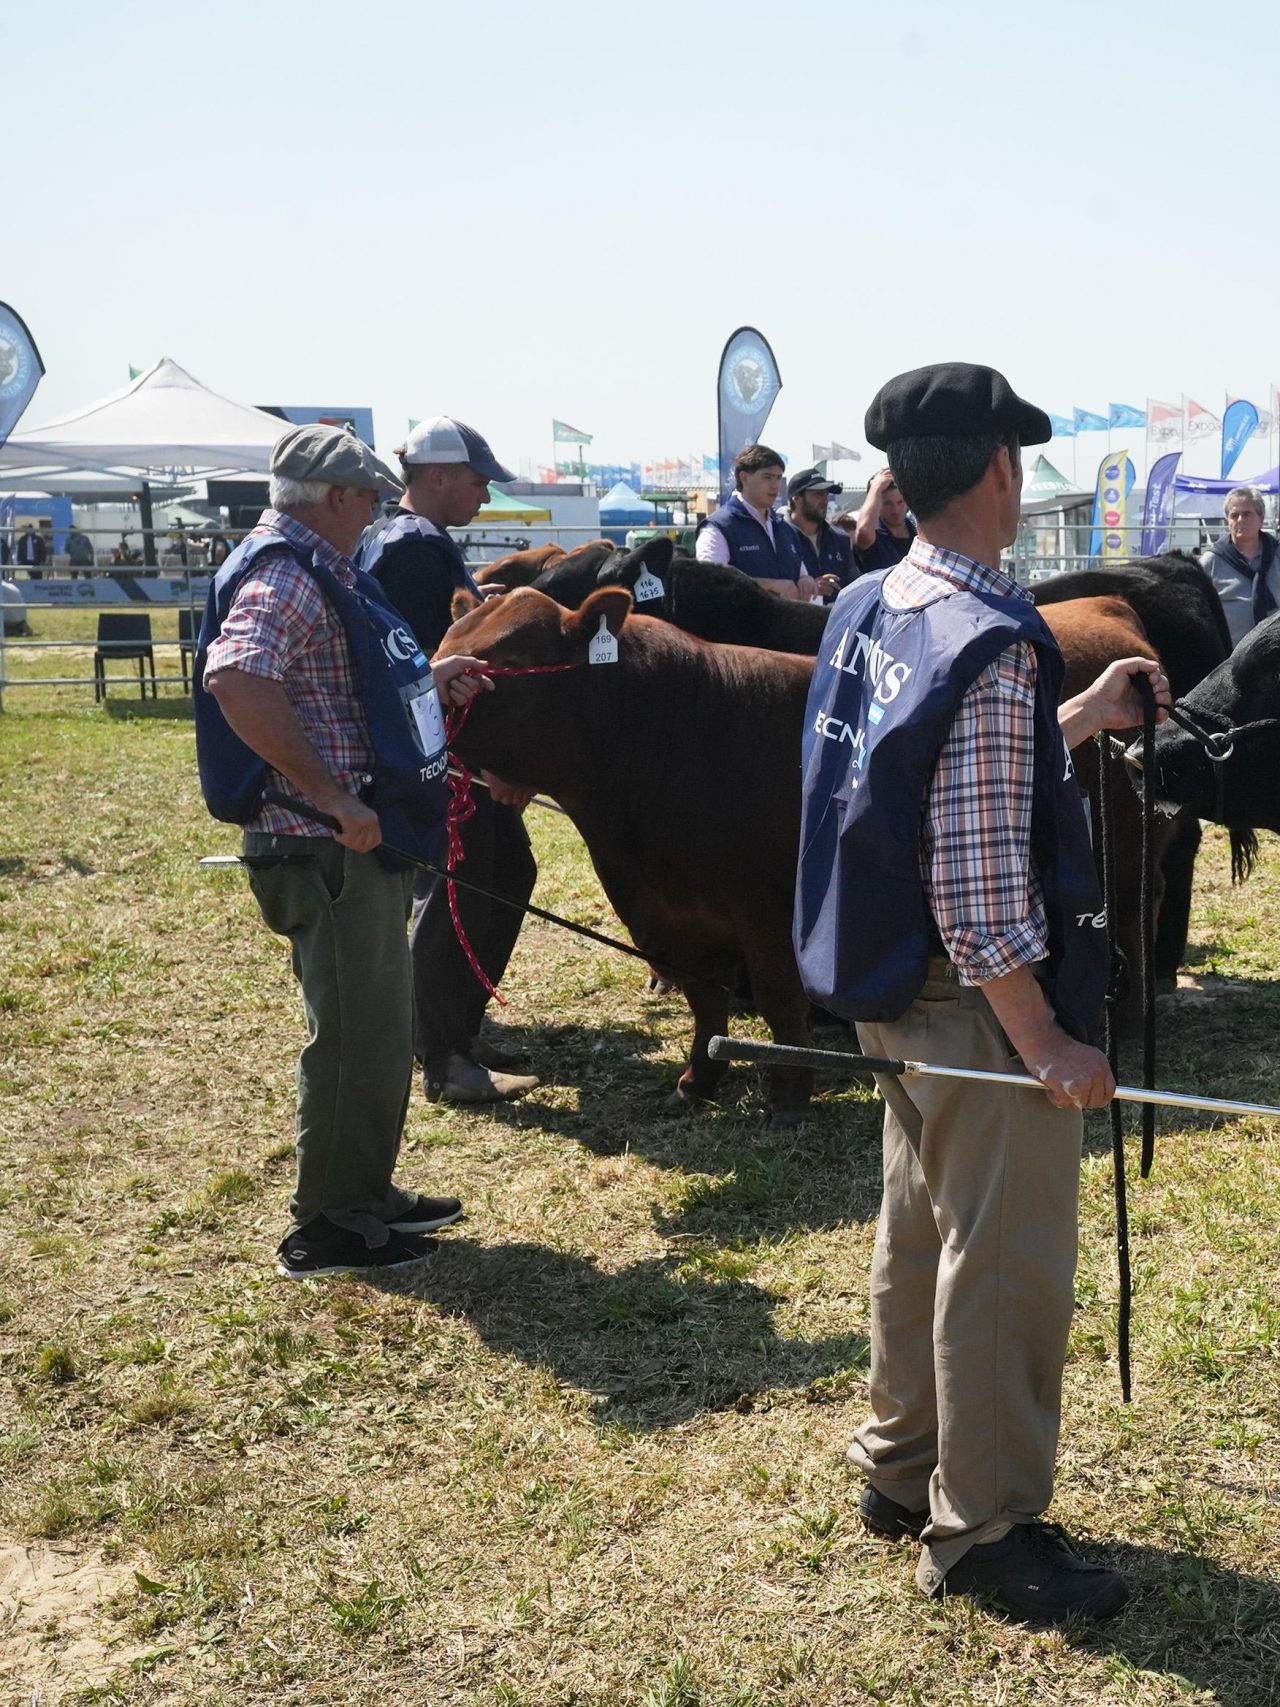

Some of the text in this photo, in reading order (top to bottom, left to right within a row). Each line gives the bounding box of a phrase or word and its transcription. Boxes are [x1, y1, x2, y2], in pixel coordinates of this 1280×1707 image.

[640, 578, 654, 589] 116
[639, 587, 660, 599] 1675
[596, 634, 612, 645] 169
[595, 652, 612, 662] 207
